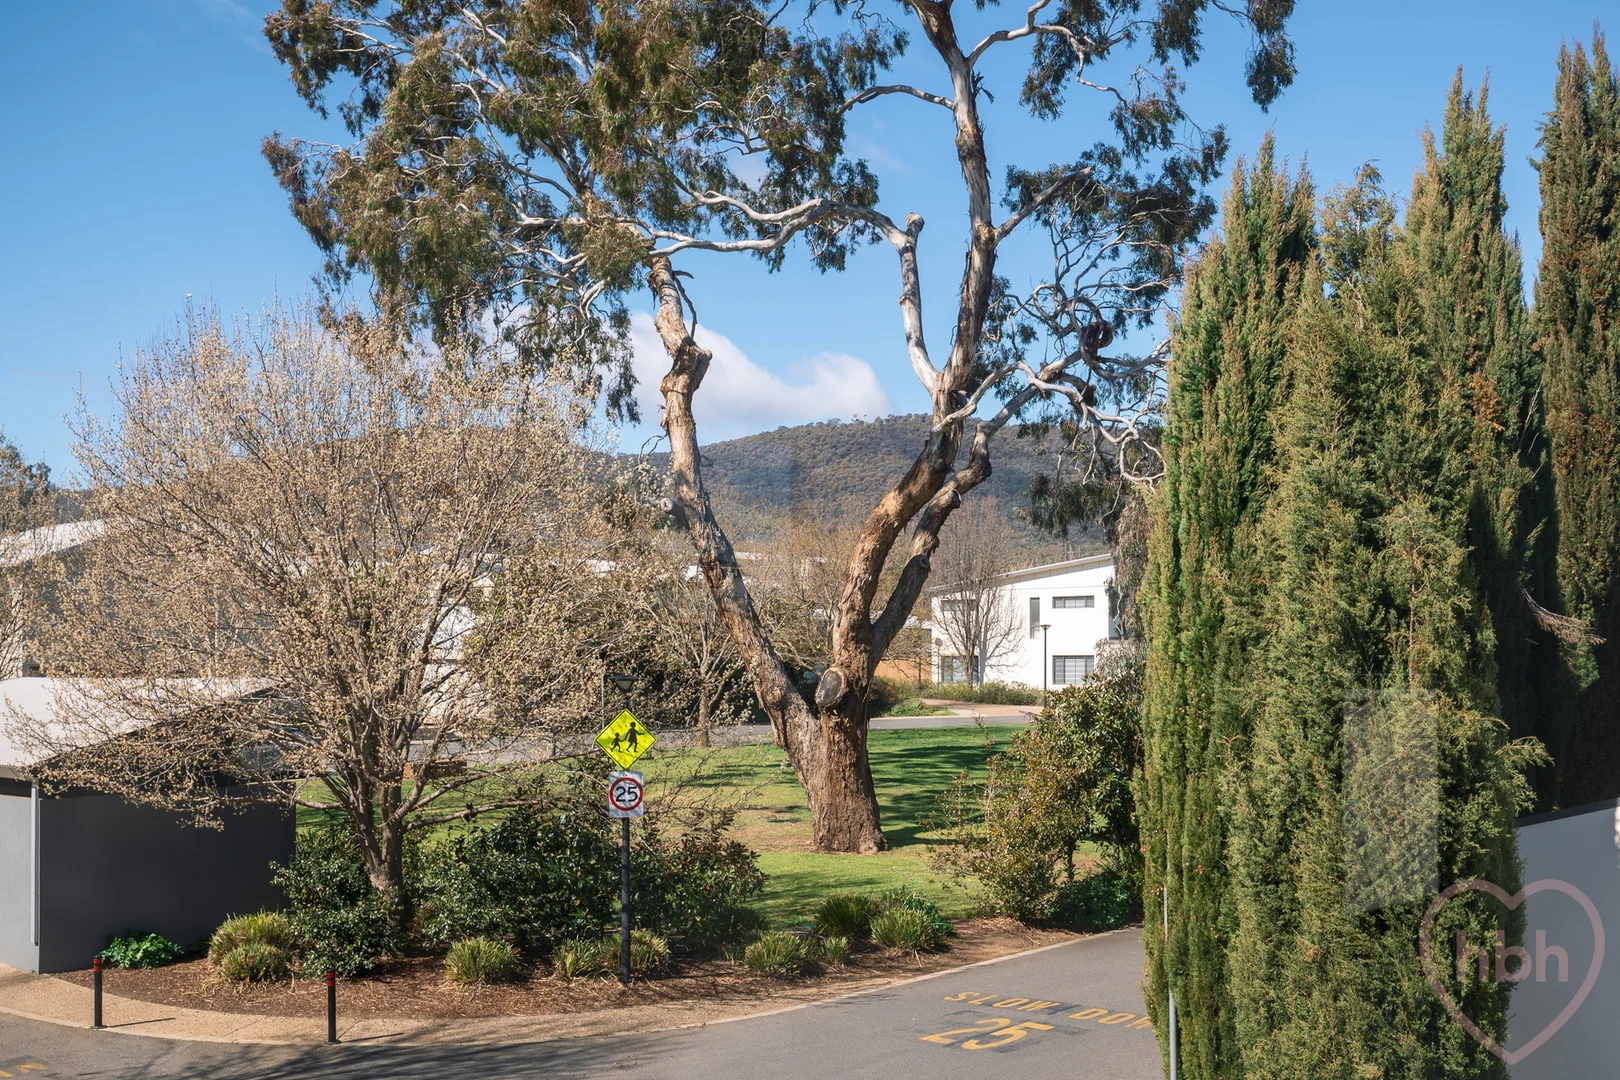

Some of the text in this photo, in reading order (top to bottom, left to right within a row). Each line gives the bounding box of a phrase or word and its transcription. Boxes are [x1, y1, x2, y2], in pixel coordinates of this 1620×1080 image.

[615, 786, 638, 802] 25
[943, 991, 1157, 1033] SLOW DOW
[919, 1017, 1056, 1050] 25
